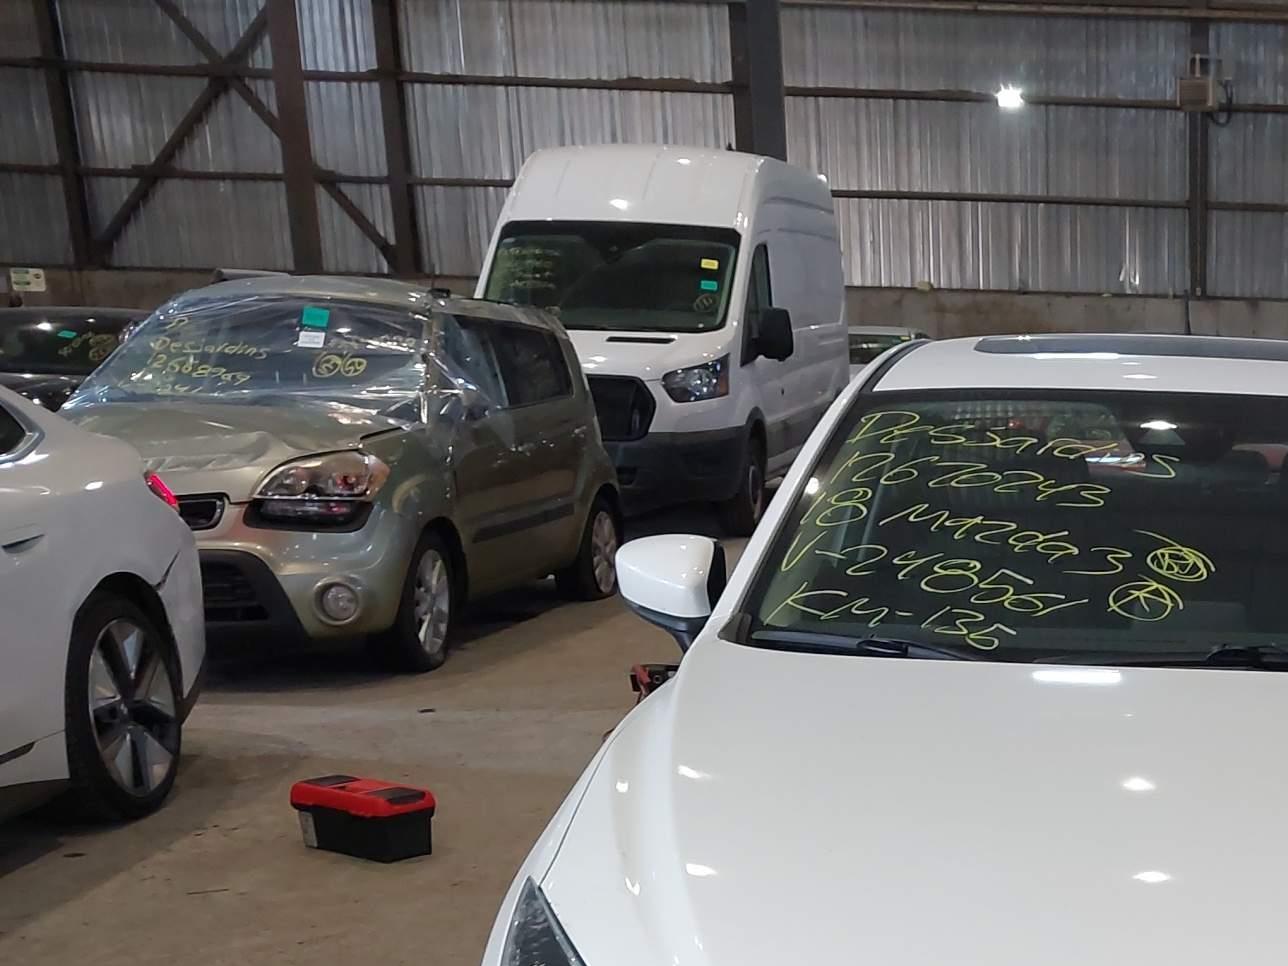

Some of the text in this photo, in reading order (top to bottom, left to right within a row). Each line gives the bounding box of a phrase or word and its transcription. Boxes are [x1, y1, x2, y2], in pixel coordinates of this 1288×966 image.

[830, 451, 1112, 508] 12670243
[799, 487, 873, 527] 18
[1062, 546, 1133, 575] 3
